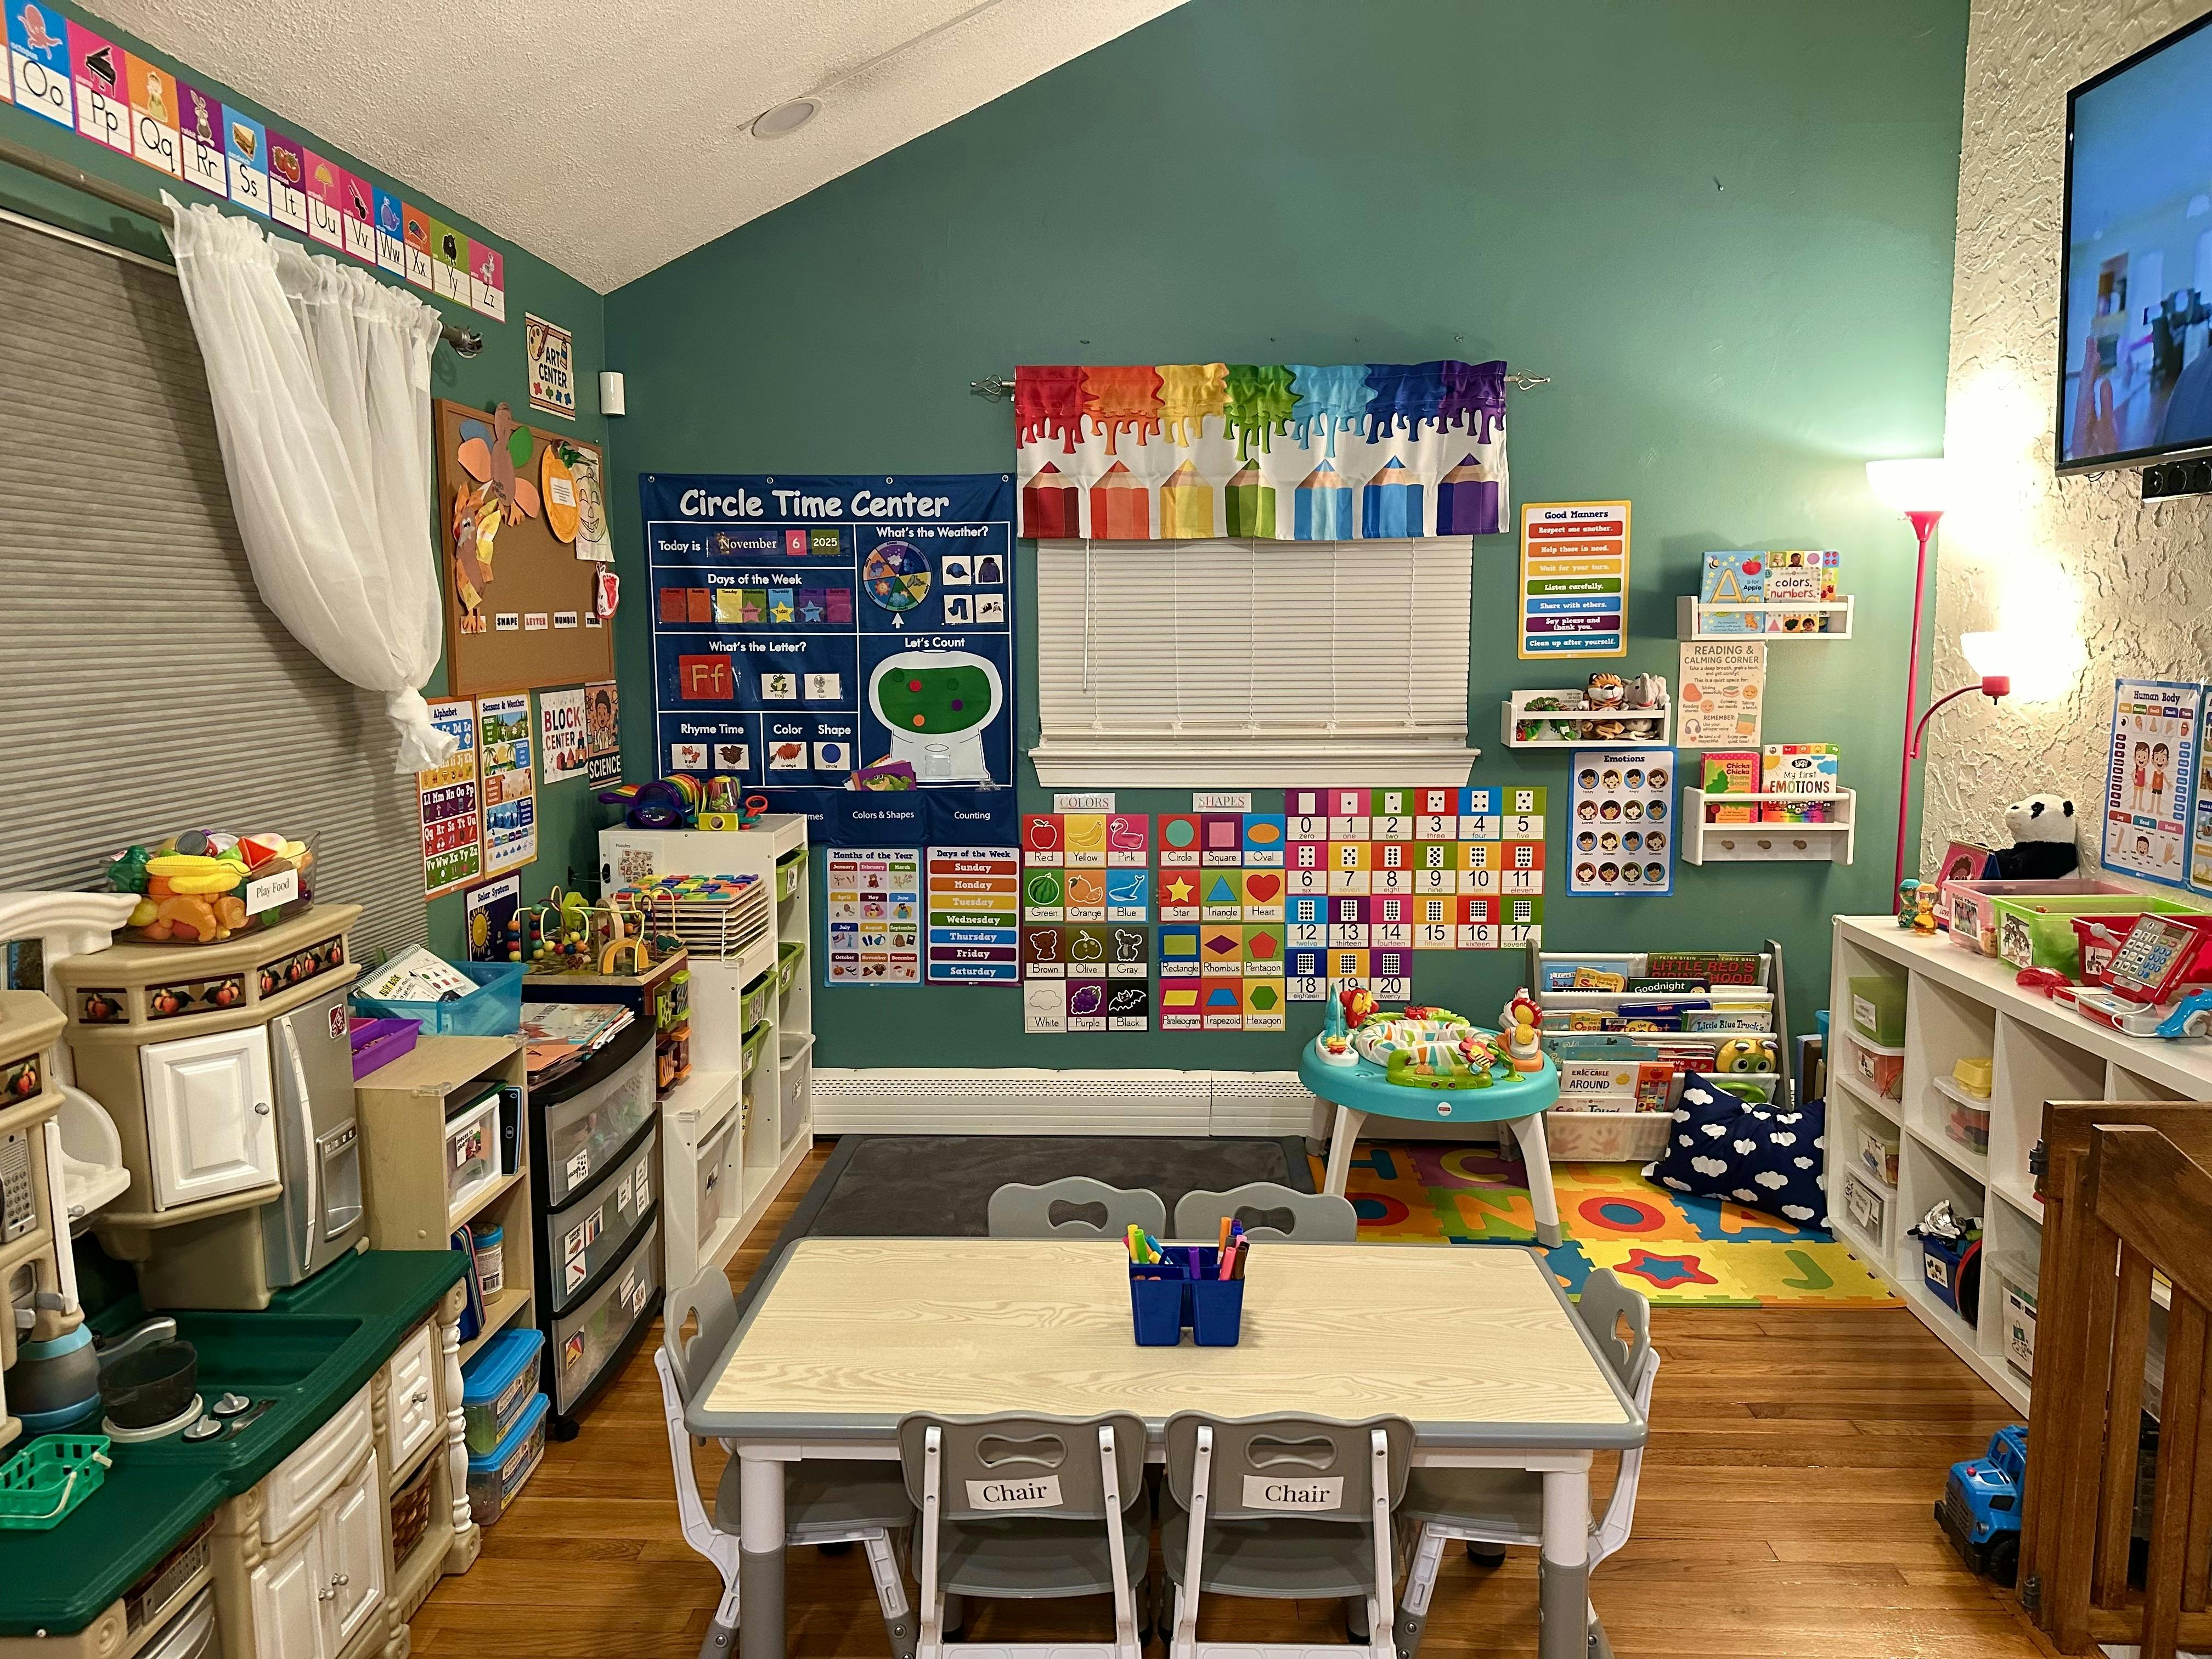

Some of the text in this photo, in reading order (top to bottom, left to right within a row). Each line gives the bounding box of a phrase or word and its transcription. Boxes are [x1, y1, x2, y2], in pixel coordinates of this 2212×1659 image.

[23, 60, 63, 106] Oo
[91, 89, 118, 144] Pp
[140, 117, 176, 173] Qq
[195, 142, 217, 178] Rr
[239, 163, 257, 197] Ss
[280, 182, 296, 216] Tt
[314, 199, 336, 234] Uu
[352, 217, 368, 249] Vv
[380, 230, 400, 263] Ww
[412, 247, 426, 277] Xx
[446, 264, 458, 301] Yy
[483, 282, 495, 308] Zz
[546, 347, 560, 368] ART
[538, 363, 567, 388] CENTER
[680, 488, 949, 518] Circle Time Center
[1571, 510, 1609, 518] Manners
[876, 525, 989, 538] What's the Weather?
[658, 540, 701, 553] Today is
[720, 537, 838, 550] November 6 2025
[708, 574, 802, 586] Days of the Week
[497, 617, 518, 626] SHAPE
[526, 617, 546, 626] LETTER
[555, 616, 576, 624] NUMBER
[709, 641, 806, 652] What's the Letter?
[905, 637, 965, 649] Let's Count
[1695, 645, 1754, 655] READING &
[691, 663, 724, 693] Ff
[2134, 690, 2181, 705] Human Body
[483, 701, 500, 712] Seasons
[507, 698, 524, 709] Weather
[433, 707, 458, 720] Alphabet
[544, 706, 582, 732] BLOCK
[681, 724, 744, 737] Rhyme Time
[773, 724, 803, 735] Color
[818, 724, 851, 737] Shape
[545, 731, 575, 751] CENTER
[589, 755, 622, 780] SCIENCE
[1770, 780, 1830, 793] EMOTIONS
[1059, 797, 1109, 809] COLORS
[1198, 796, 1245, 808] SHAPES
[853, 810, 915, 820] Colors & Shapes
[954, 811, 990, 821] Counting
[1386, 816, 1398, 833] 2
[1430, 815, 1442, 832] 3
[1473, 815, 1485, 833] 4
[1517, 815, 1529, 833] 5
[833, 851, 863, 860] Months
[866, 851, 876, 860] of
[894, 852, 913, 860] Year
[936, 850, 958, 859] Days
[1034, 852, 1054, 863] Red
[1073, 853, 1098, 862] Yellow
[1167, 853, 1193, 862] Circle
[1208, 853, 1237, 864] Square
[1252, 853, 1274, 862] Oval
[955, 863, 992, 872] Sunday
[1468, 870, 1489, 887] 10
[1512, 870, 1530, 887] 11
[256, 878, 290, 898] Play Food
[954, 881, 992, 890] Monday
[477, 884, 510, 902] Solar System
[1070, 909, 1102, 920] Orange
[1116, 908, 1136, 917] Blue
[1172, 907, 1190, 917] Star
[1206, 906, 1238, 918] Triangle
[946, 915, 1001, 926] Wednesday
[956, 950, 990, 960] Friday
[950, 967, 997, 977] Saturday
[1652, 961, 1754, 973] LITTLE RED'S
[1710, 973, 1754, 984] HOOD
[379, 974, 402, 997] BUSY BOOK
[1635, 981, 1685, 994] Goodnight
[1035, 1017, 1059, 1028] White
[1075, 1018, 1101, 1029] Purple
[1205, 1016, 1241, 1027] Trapezoid
[1246, 1016, 1282, 1028] Hexagon
[1697, 1019, 1764, 1031] Little Blue Truck's
[1570, 1080, 1610, 1089] AROUND
[983, 1483, 1047, 1503] Chair
[1265, 1485, 1330, 1503] Chair
